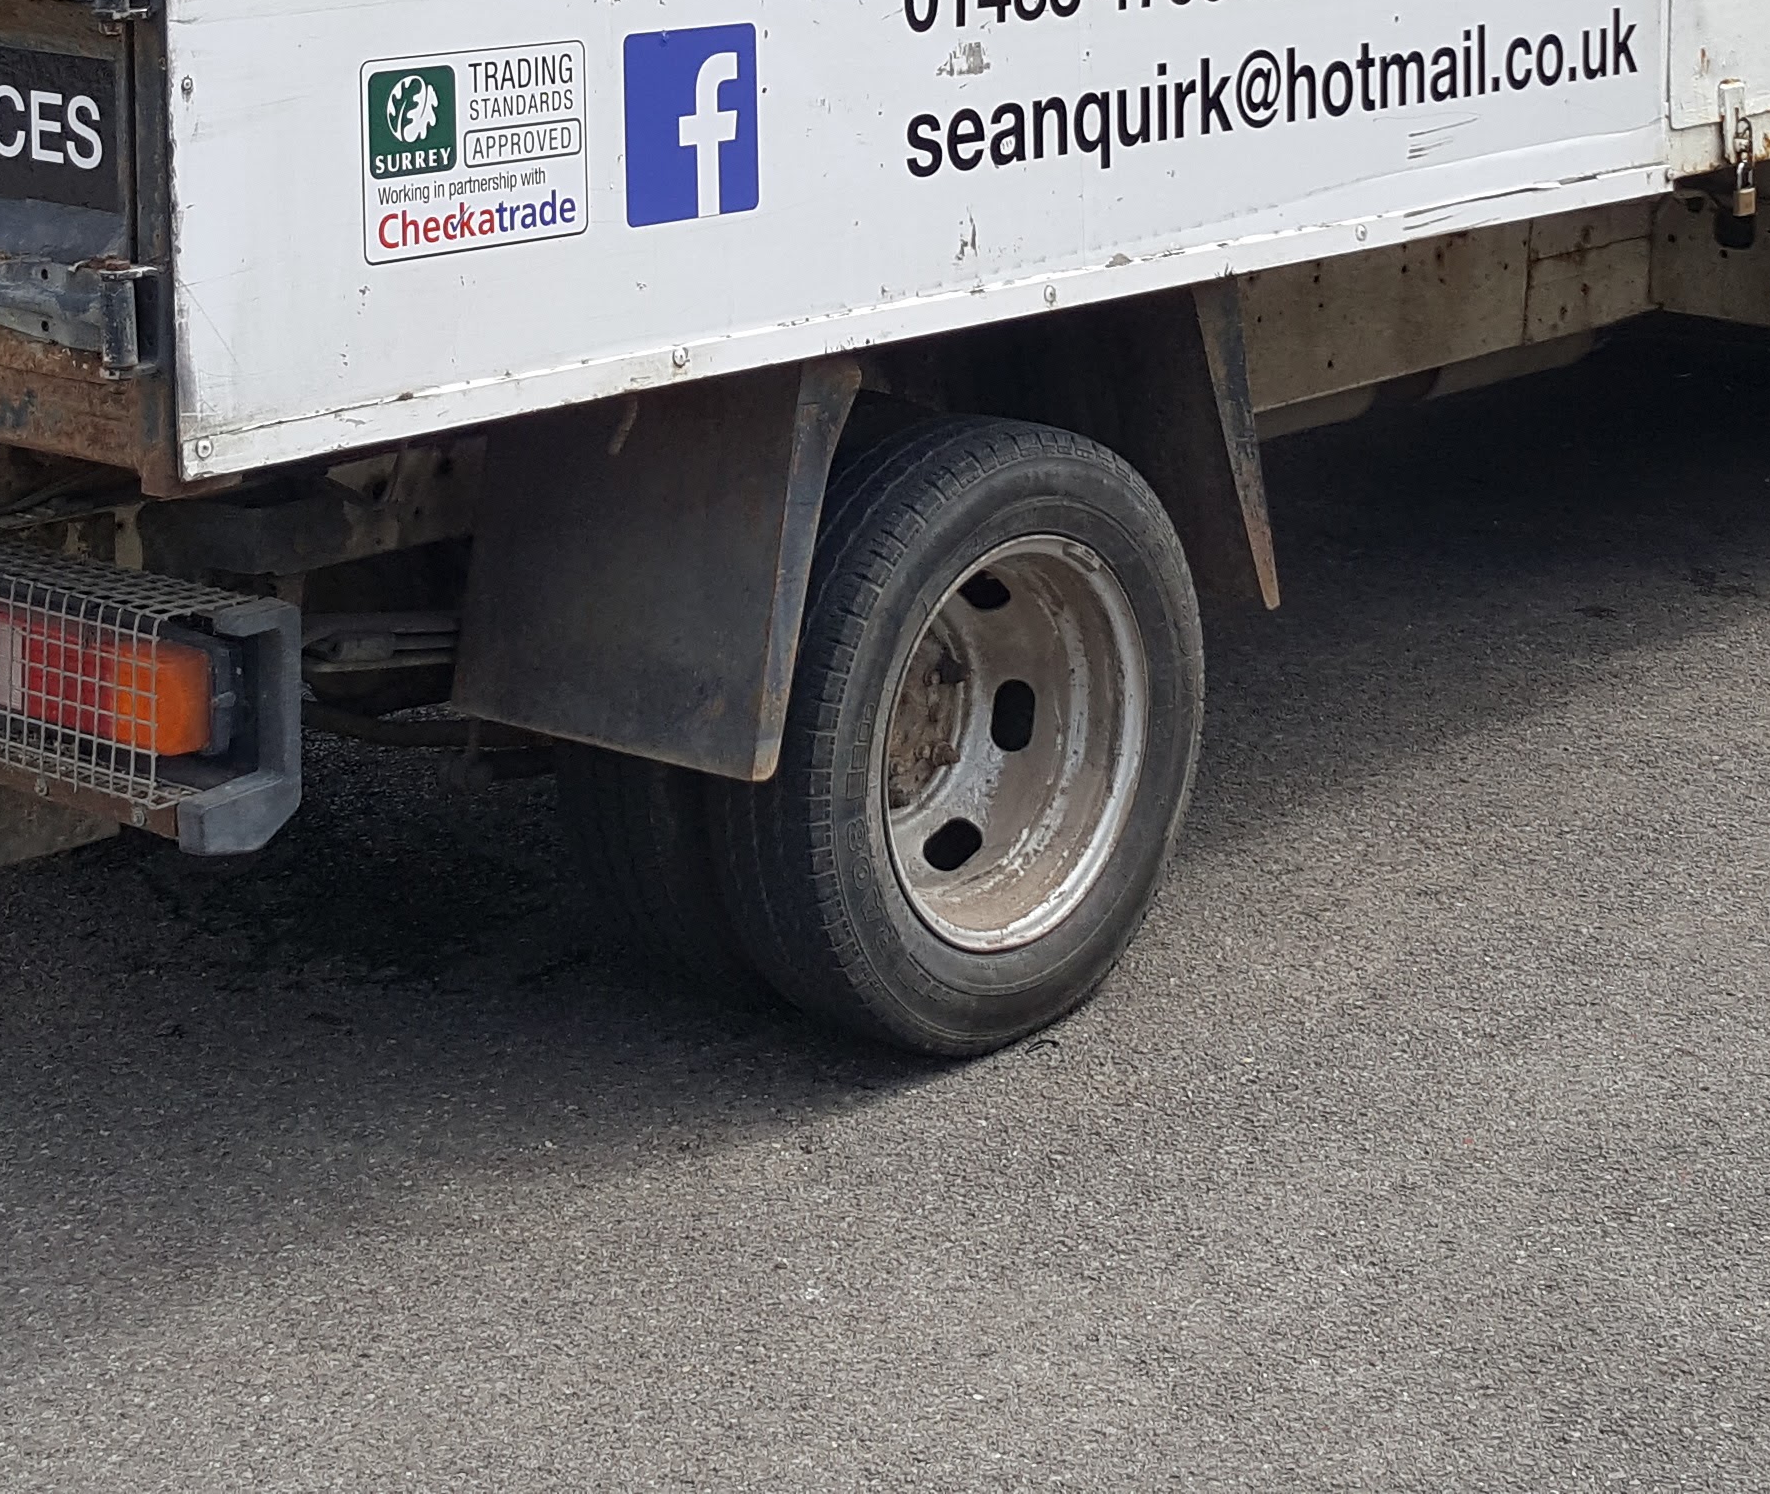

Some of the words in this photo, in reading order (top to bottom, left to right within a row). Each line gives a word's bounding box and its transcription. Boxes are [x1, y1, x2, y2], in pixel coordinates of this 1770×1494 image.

[469, 54, 572, 93] TRADING
[907, 8, 1637, 177] seanquirk@hotmail.co.uk
[470, 89, 573, 120] STANDARDS
[376, 147, 450, 173] SURREY
[473, 127, 571, 159] APPROVED
[378, 185, 429, 205] Working
[435, 184, 444, 198] in
[449, 173, 517, 200] partnership
[521, 167, 545, 186] with
[379, 191, 575, 248] Checkatrade
